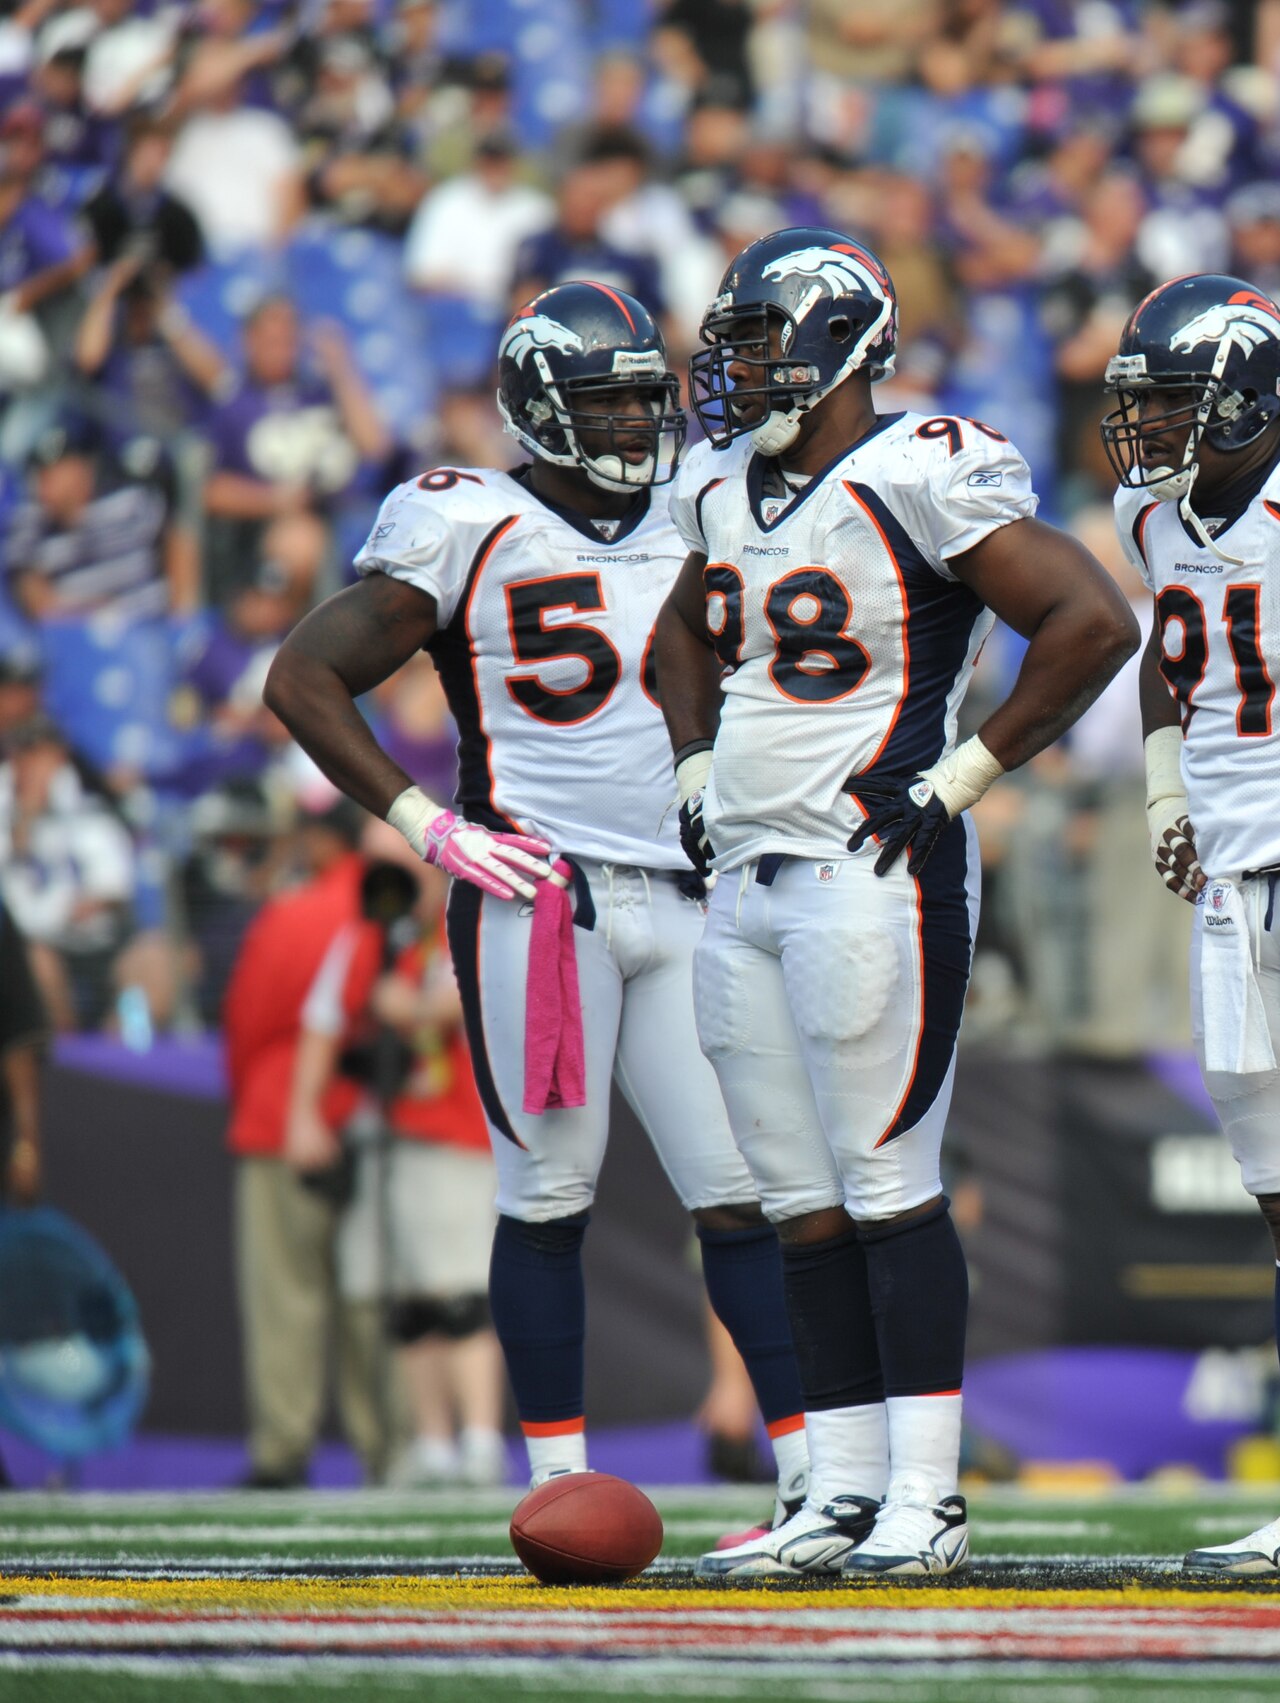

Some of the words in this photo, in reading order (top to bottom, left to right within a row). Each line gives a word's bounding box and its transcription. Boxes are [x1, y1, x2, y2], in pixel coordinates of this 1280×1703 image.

[743, 544, 790, 556] BRONCOS
[576, 552, 650, 564] BRONCOS
[1174, 562, 1224, 574] BRONCOS
[703, 562, 872, 705] 98
[1155, 583, 1277, 741] 91
[1205, 915, 1235, 927] Wilson
